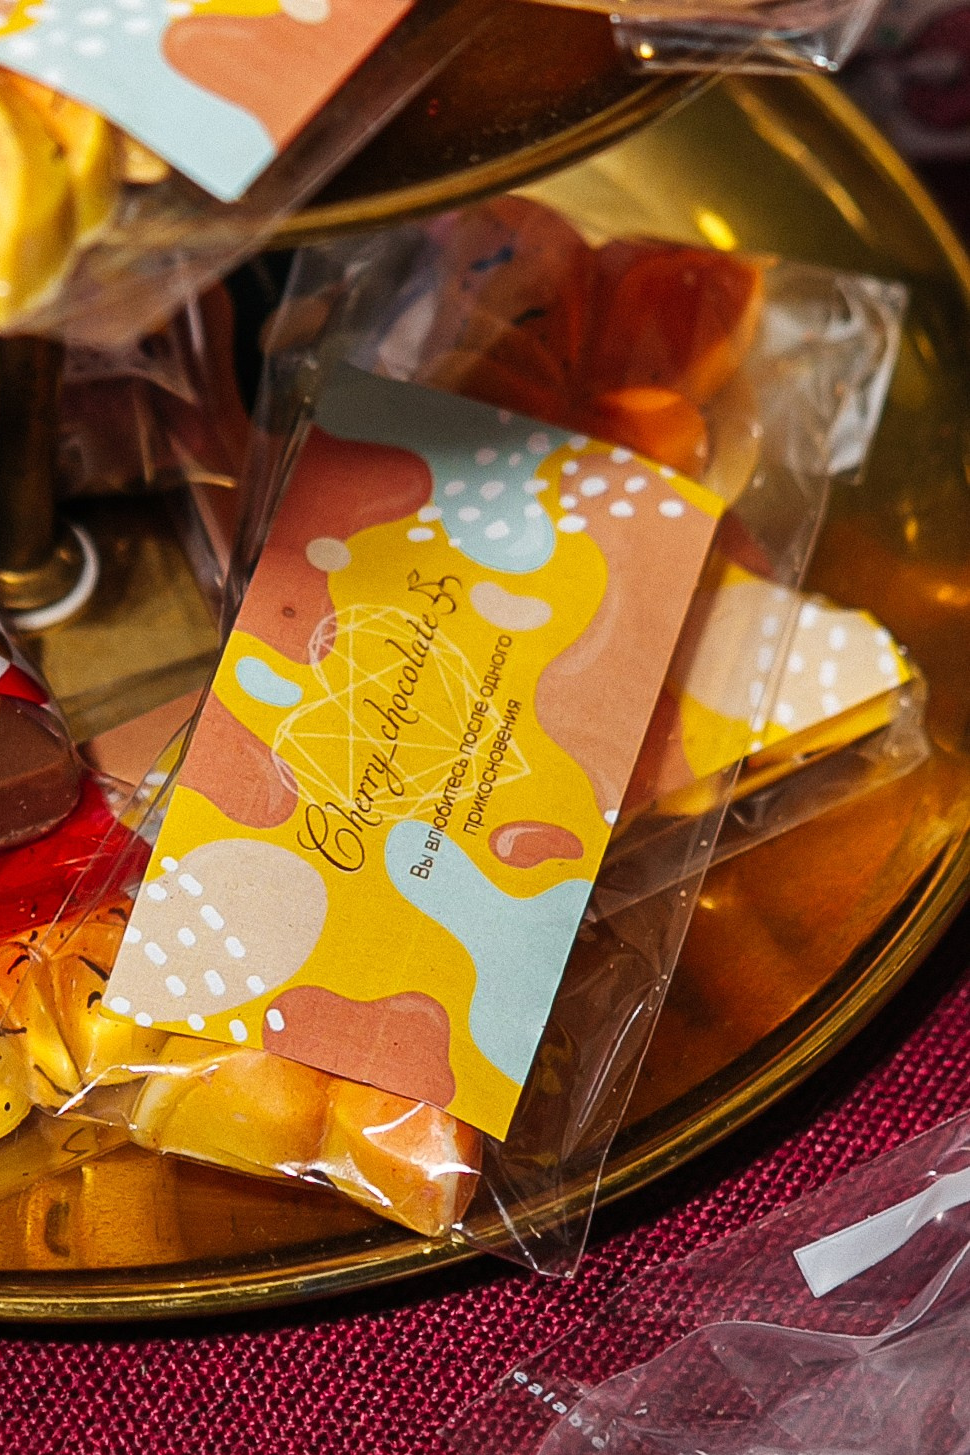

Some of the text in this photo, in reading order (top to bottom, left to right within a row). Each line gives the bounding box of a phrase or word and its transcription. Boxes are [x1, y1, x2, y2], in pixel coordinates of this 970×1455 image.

[409, 635, 513, 881] Вы влюбитесь после одного
[462, 698, 523, 836] прикосновения
[513, 1371, 606, 1449] ealable
